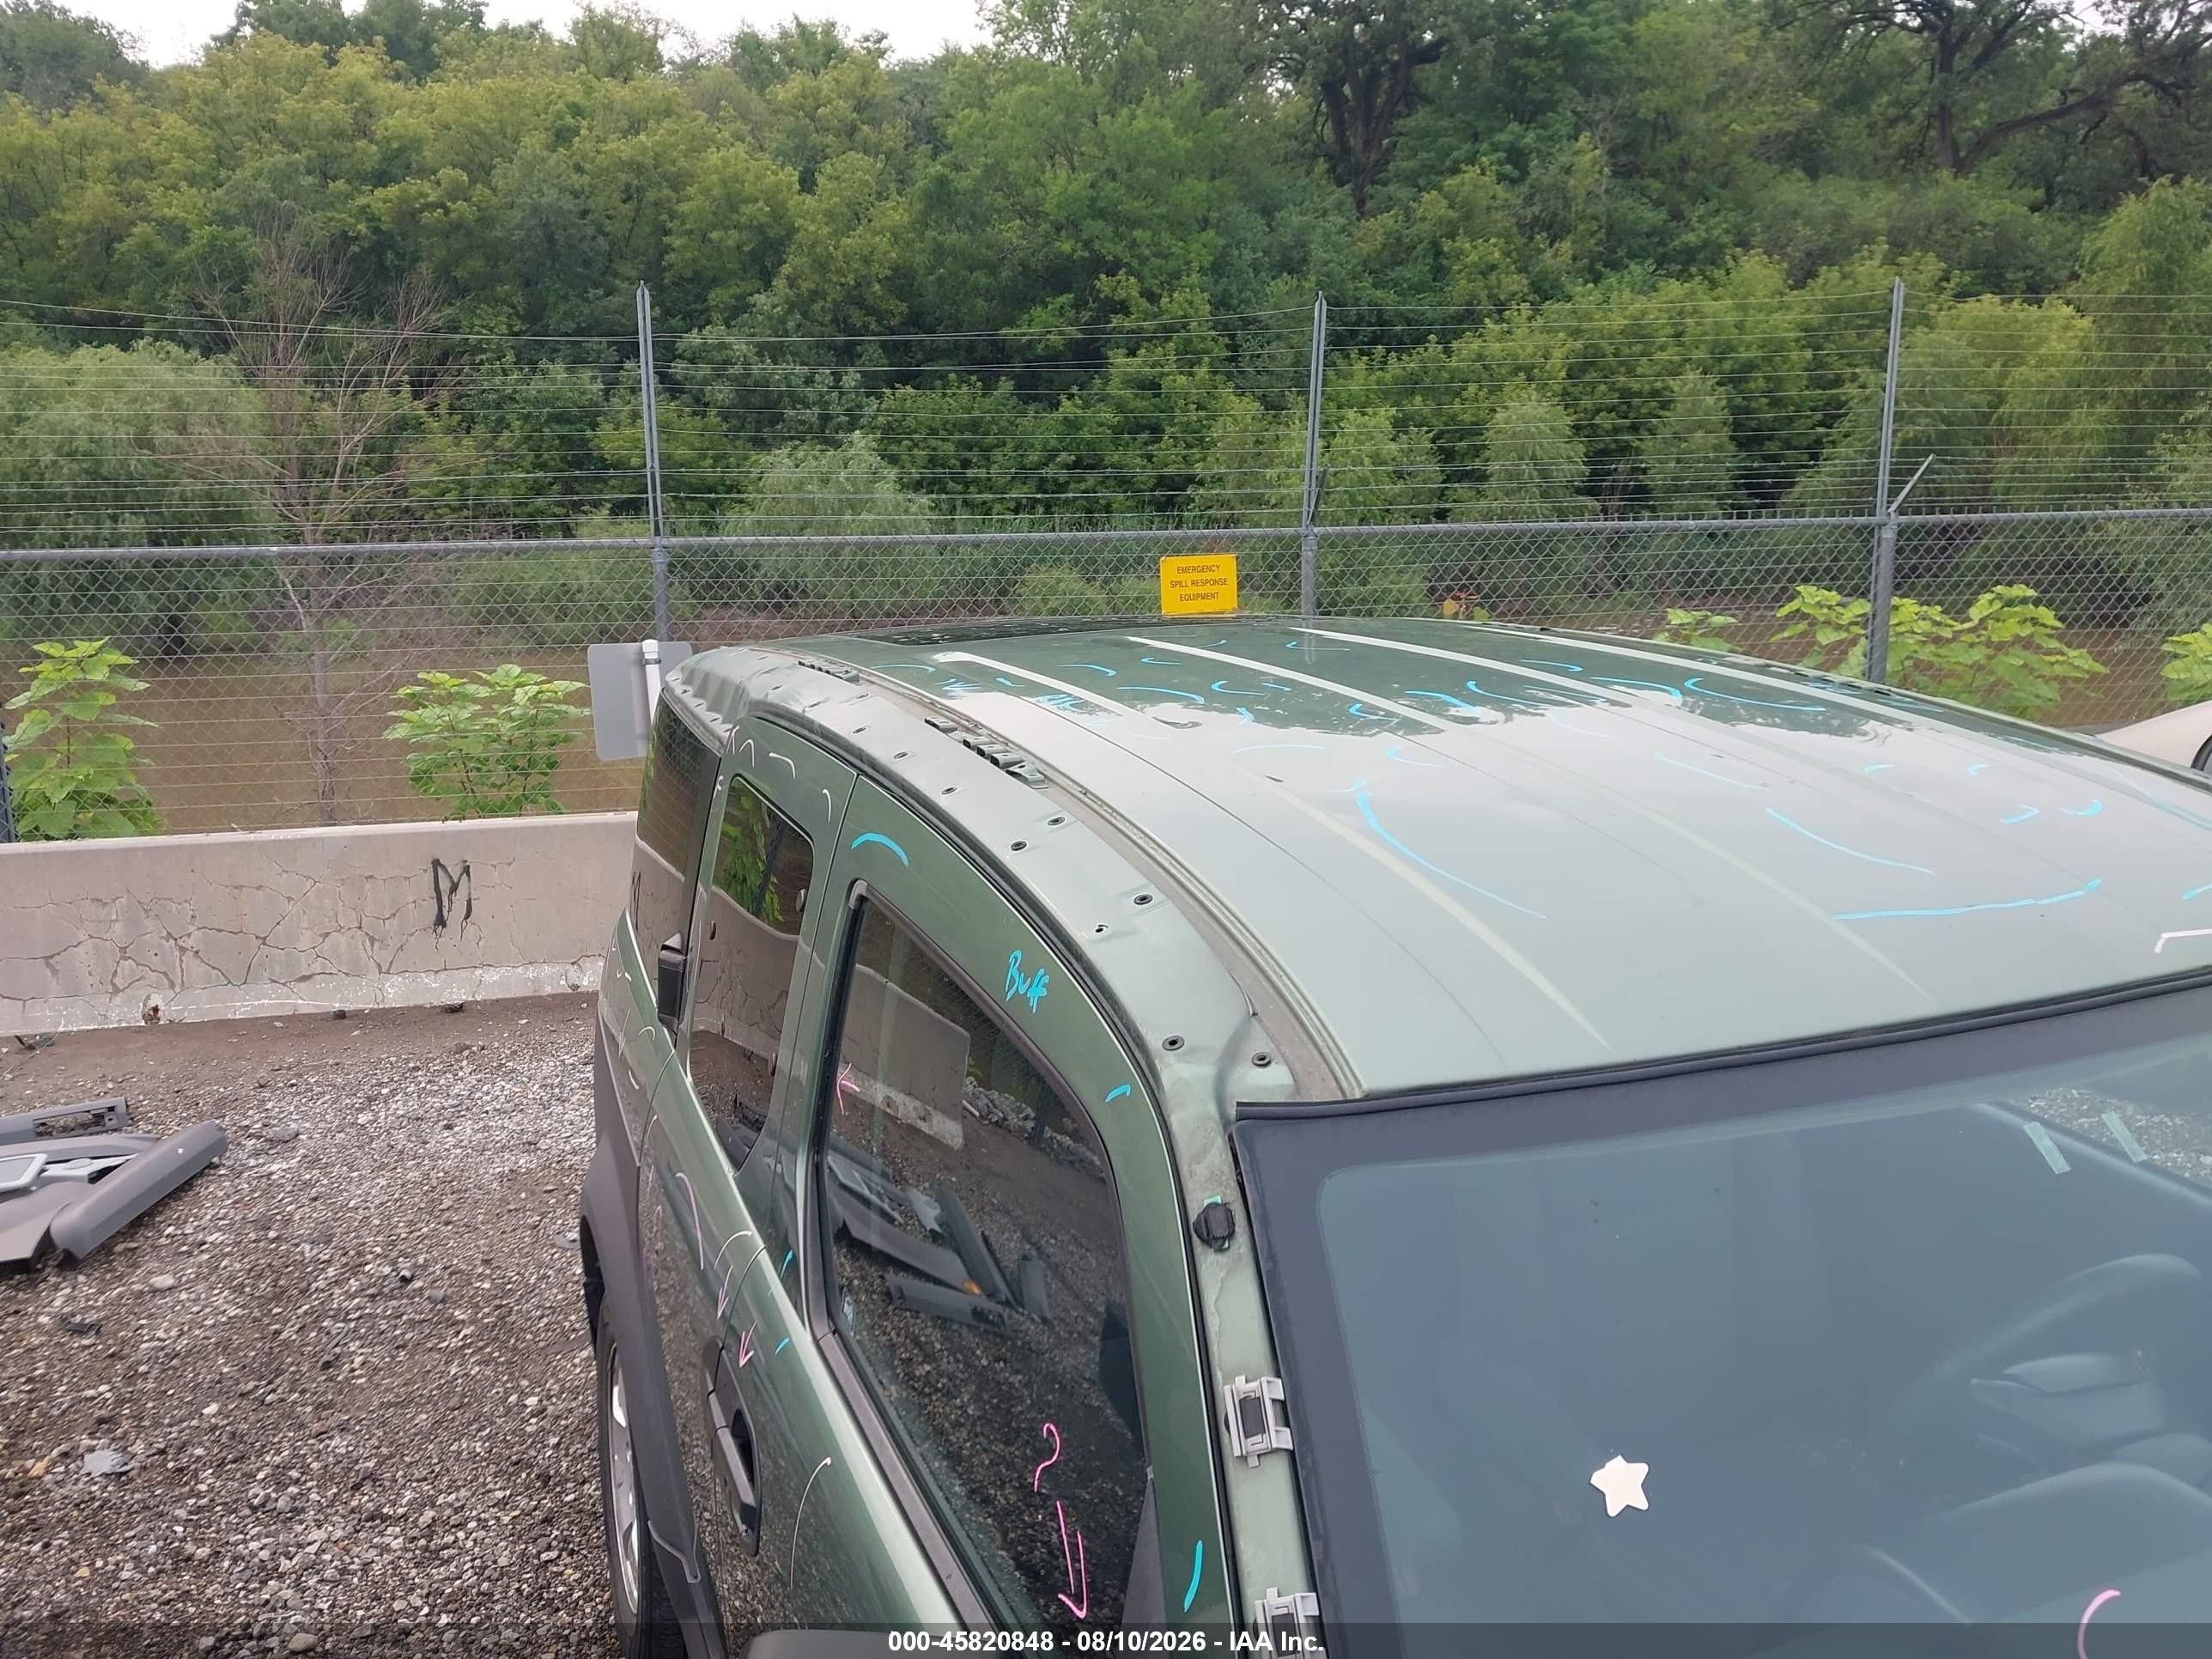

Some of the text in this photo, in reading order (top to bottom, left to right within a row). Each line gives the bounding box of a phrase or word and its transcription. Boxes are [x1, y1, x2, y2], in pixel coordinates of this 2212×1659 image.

[1176, 564, 1220, 574] EMERGENCY
[1170, 577, 1228, 588] SPILL RESPONSE
[1180, 592, 1219, 602] EQUIPMENT
